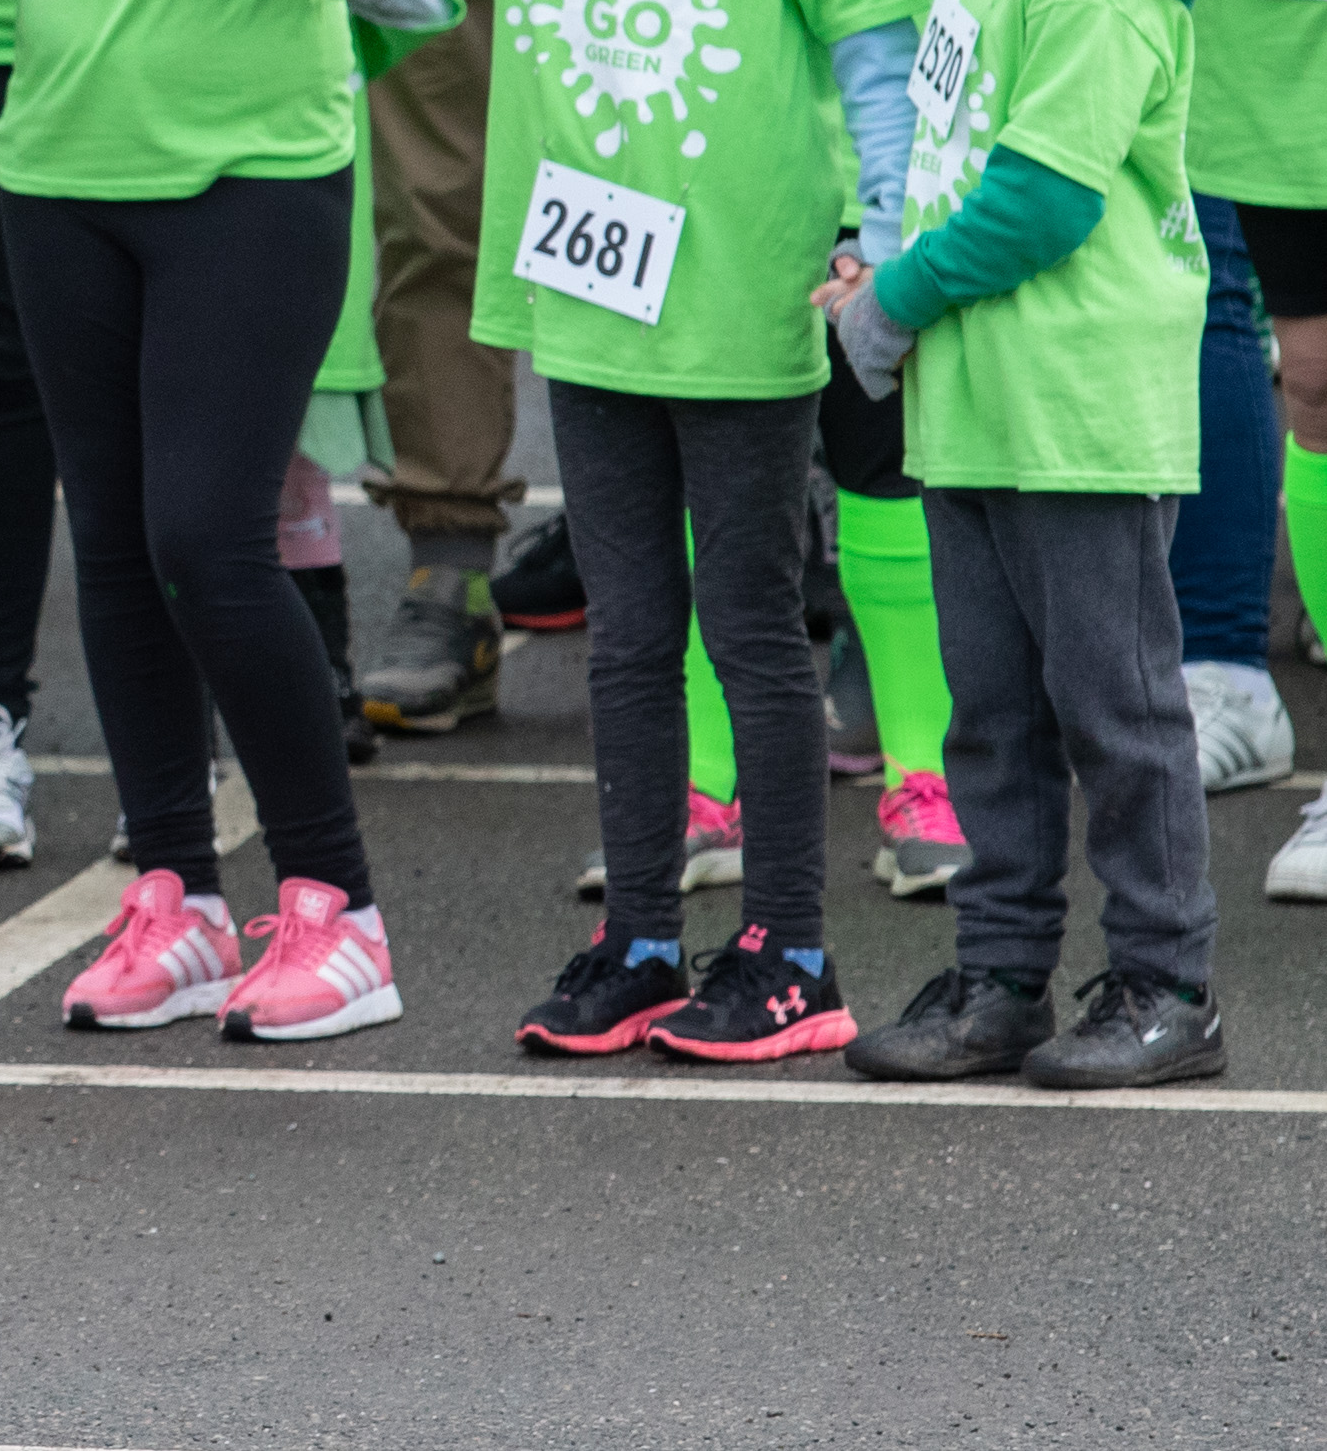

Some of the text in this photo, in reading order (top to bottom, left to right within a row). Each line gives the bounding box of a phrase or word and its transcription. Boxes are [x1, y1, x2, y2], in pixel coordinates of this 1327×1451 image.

[583, 43, 662, 75] GREEN
[918, 15, 964, 102] 2520
[532, 199, 655, 289] 2681
